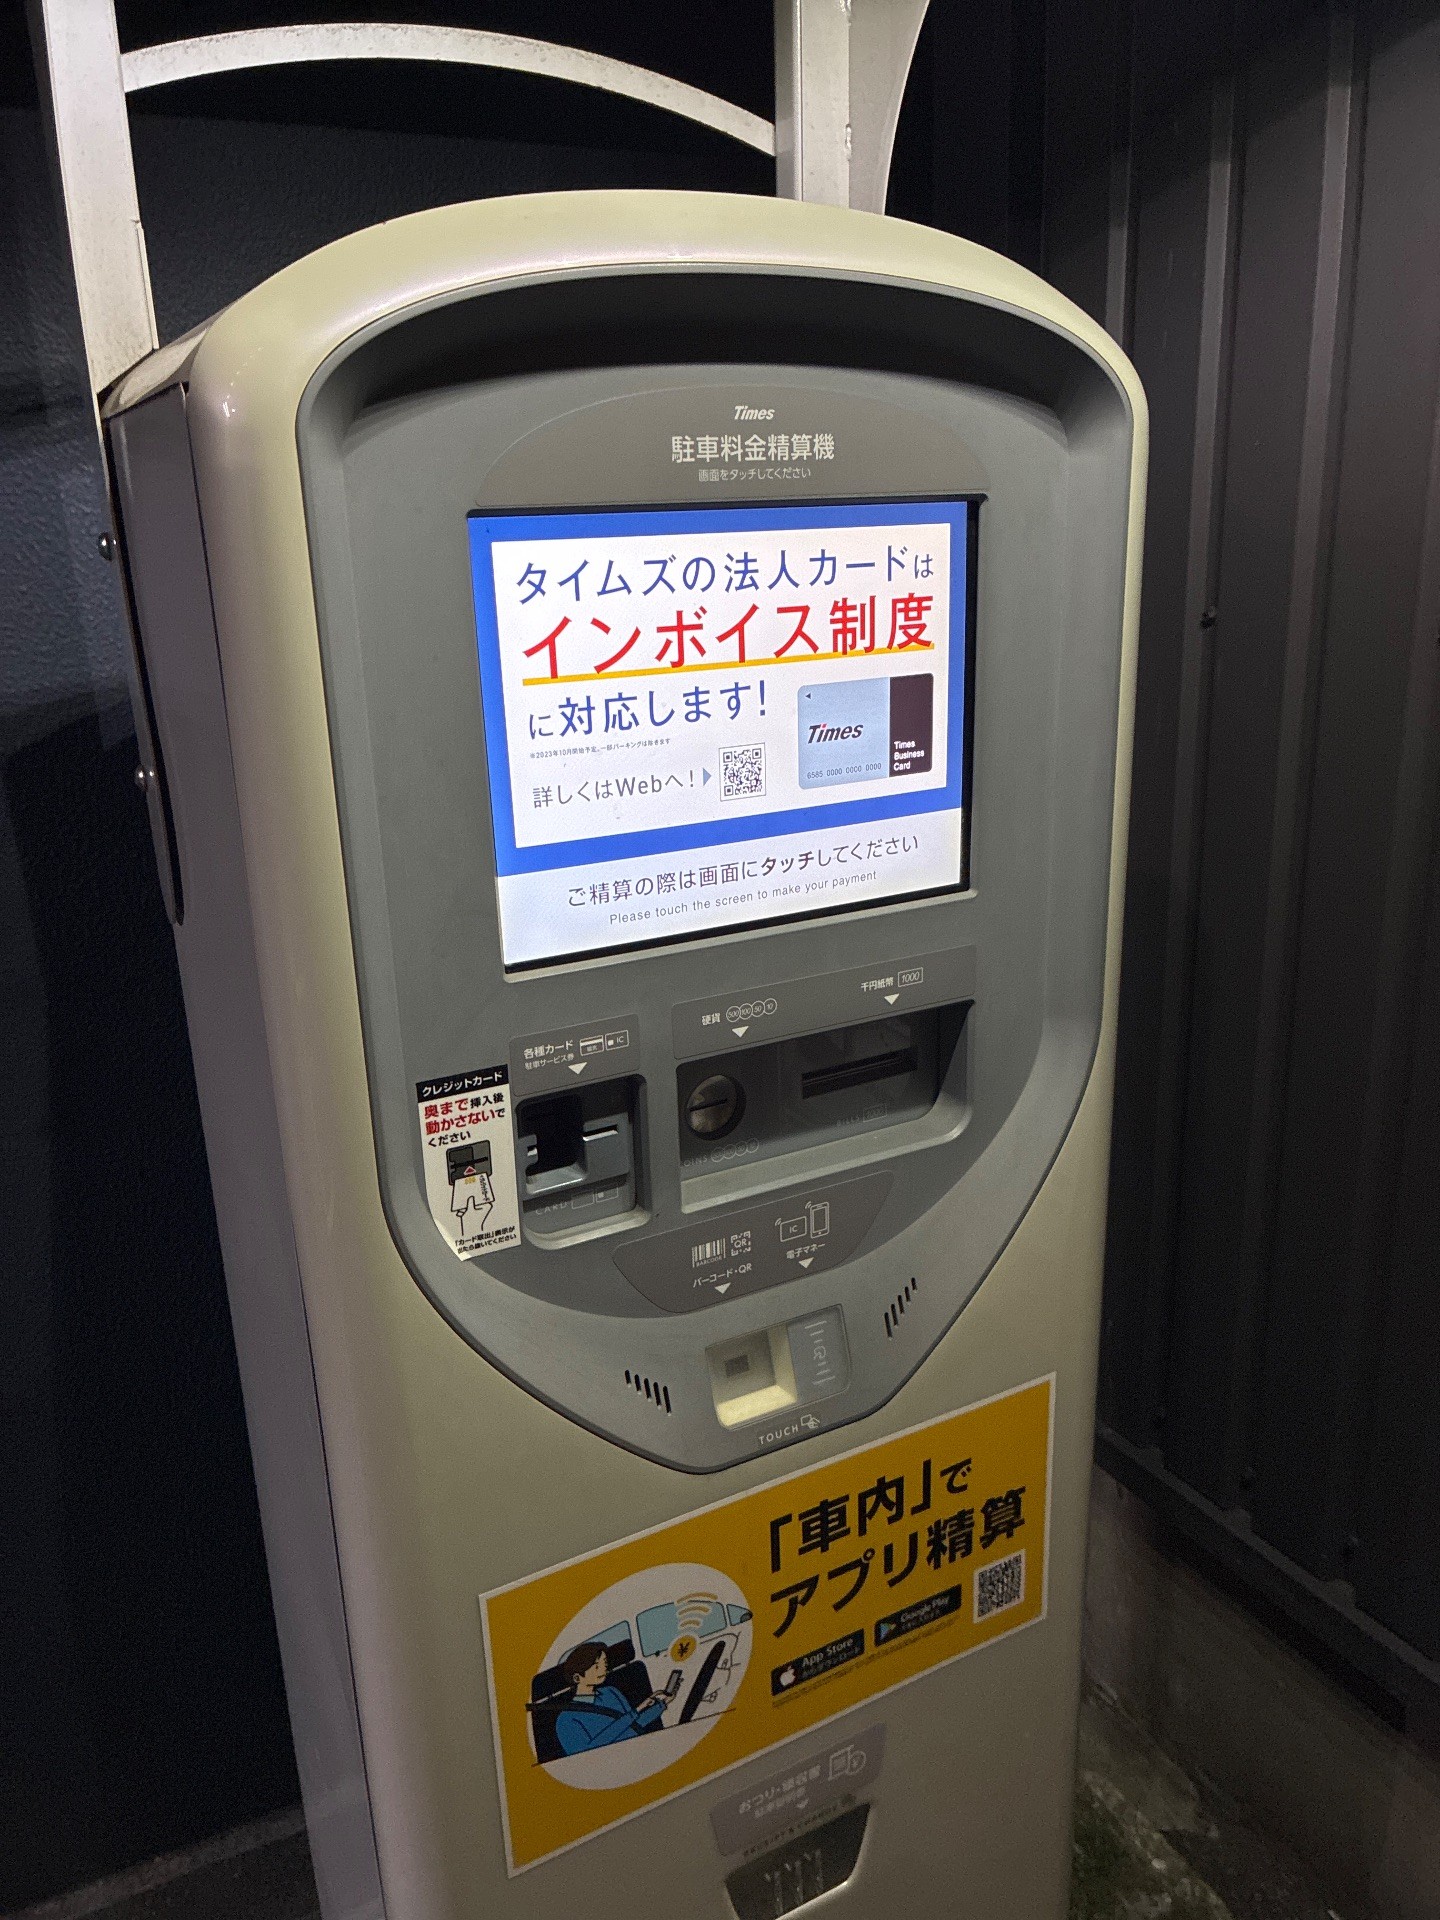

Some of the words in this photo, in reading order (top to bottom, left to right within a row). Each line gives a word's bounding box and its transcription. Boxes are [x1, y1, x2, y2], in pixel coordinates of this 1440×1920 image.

[734, 405, 775, 420] Times
[671, 433, 835, 463] 駐車料金精算機
[698, 467, 811, 482] 画面をタッチしてください
[516, 545, 934, 604] タイムズの法人カードは
[523, 593, 934, 679] インボイス制度
[529, 680, 767, 740] に対応します!
[807, 723, 863, 744] Times
[894, 741, 916, 750] Times
[893, 761, 911, 771] Card
[894, 750, 924, 760] Business
[807, 769, 823, 779] 6585
[826, 767, 843, 777] 0000
[865, 762, 882, 771] 0000
[532, 769, 694, 808] 詳しくはWebへ!
[568, 835, 919, 907] ご精算の際は画面にタッチしてください
[609, 909, 651, 925] Please
[655, 902, 689, 917] touch
[692, 898, 711, 911] the
[715, 894, 753, 907] screen
[757, 889, 769, 900] to
[772, 883, 801, 897] make
[804, 878, 829, 895] your
[832, 870, 877, 890] payment
[901, 971, 920, 984] 1000
[523, 1039, 573, 1060] 各種カード
[616, 1035, 624, 1044] IC
[422, 1071, 503, 1097] クレジットカード
[424, 1093, 504, 1119] 奥まで挿入後
[425, 1108, 505, 1135] 動かさないで
[428, 1131, 471, 1148] ください
[789, 1224, 798, 1234] IC
[734, 1238, 747, 1249] QR
[786, 1243, 826, 1259] 電子マネー
[692, 1263, 753, 1288] バーコード・QR
[758, 1424, 799, 1445] TOUCH
[770, 1458, 972, 1574] 「車内」で
[770, 1486, 1026, 1639] アプリ精算
[801, 1652, 824, 1667] App
[825, 1638, 853, 1655] Store
[738, 1764, 822, 1814] おつり・
